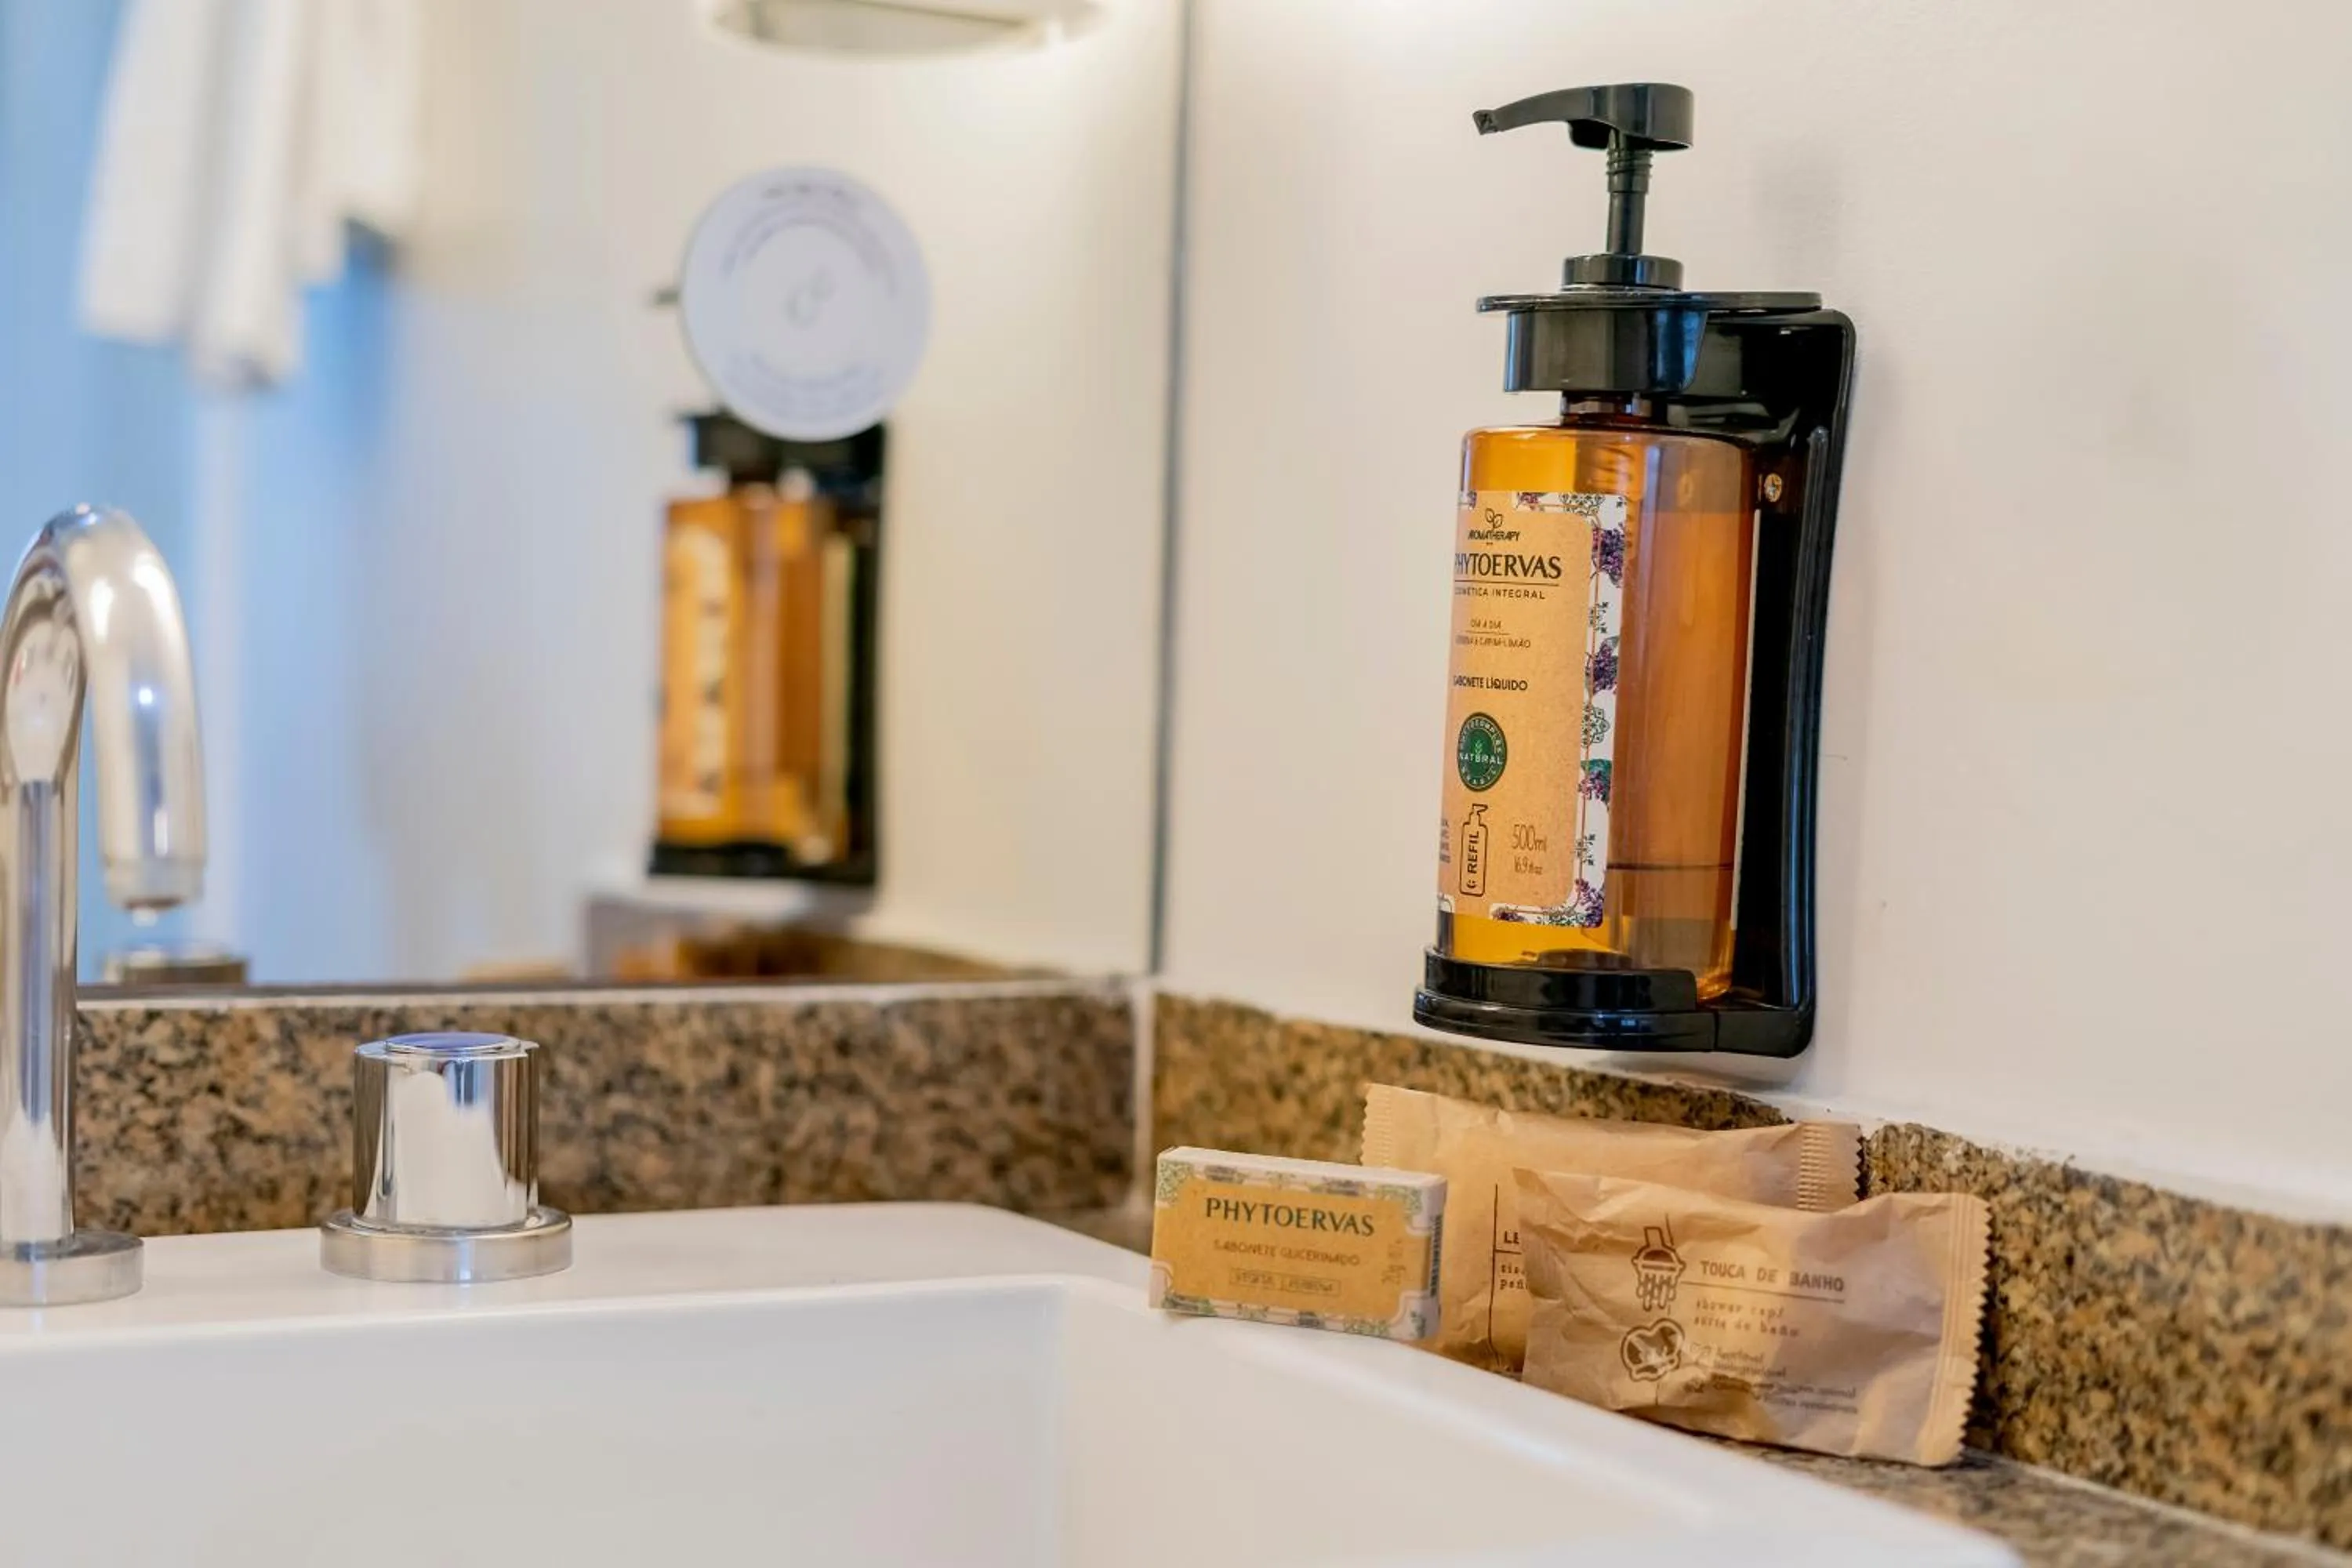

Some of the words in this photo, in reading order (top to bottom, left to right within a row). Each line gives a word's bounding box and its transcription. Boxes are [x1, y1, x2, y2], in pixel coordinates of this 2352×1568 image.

[1492, 589, 1545, 600] INTEGRAL
[1486, 677, 1528, 691] LÍQUIDO
[1467, 831, 1479, 874] REFIL
[1512, 824, 1547, 852] 500ml
[1206, 1196, 1375, 1238] PHYTOERVAS
[1700, 1260, 1745, 1281] TOUCA
[1756, 1266, 1780, 1283] DE
[1789, 1270, 1845, 1293] BANHO
